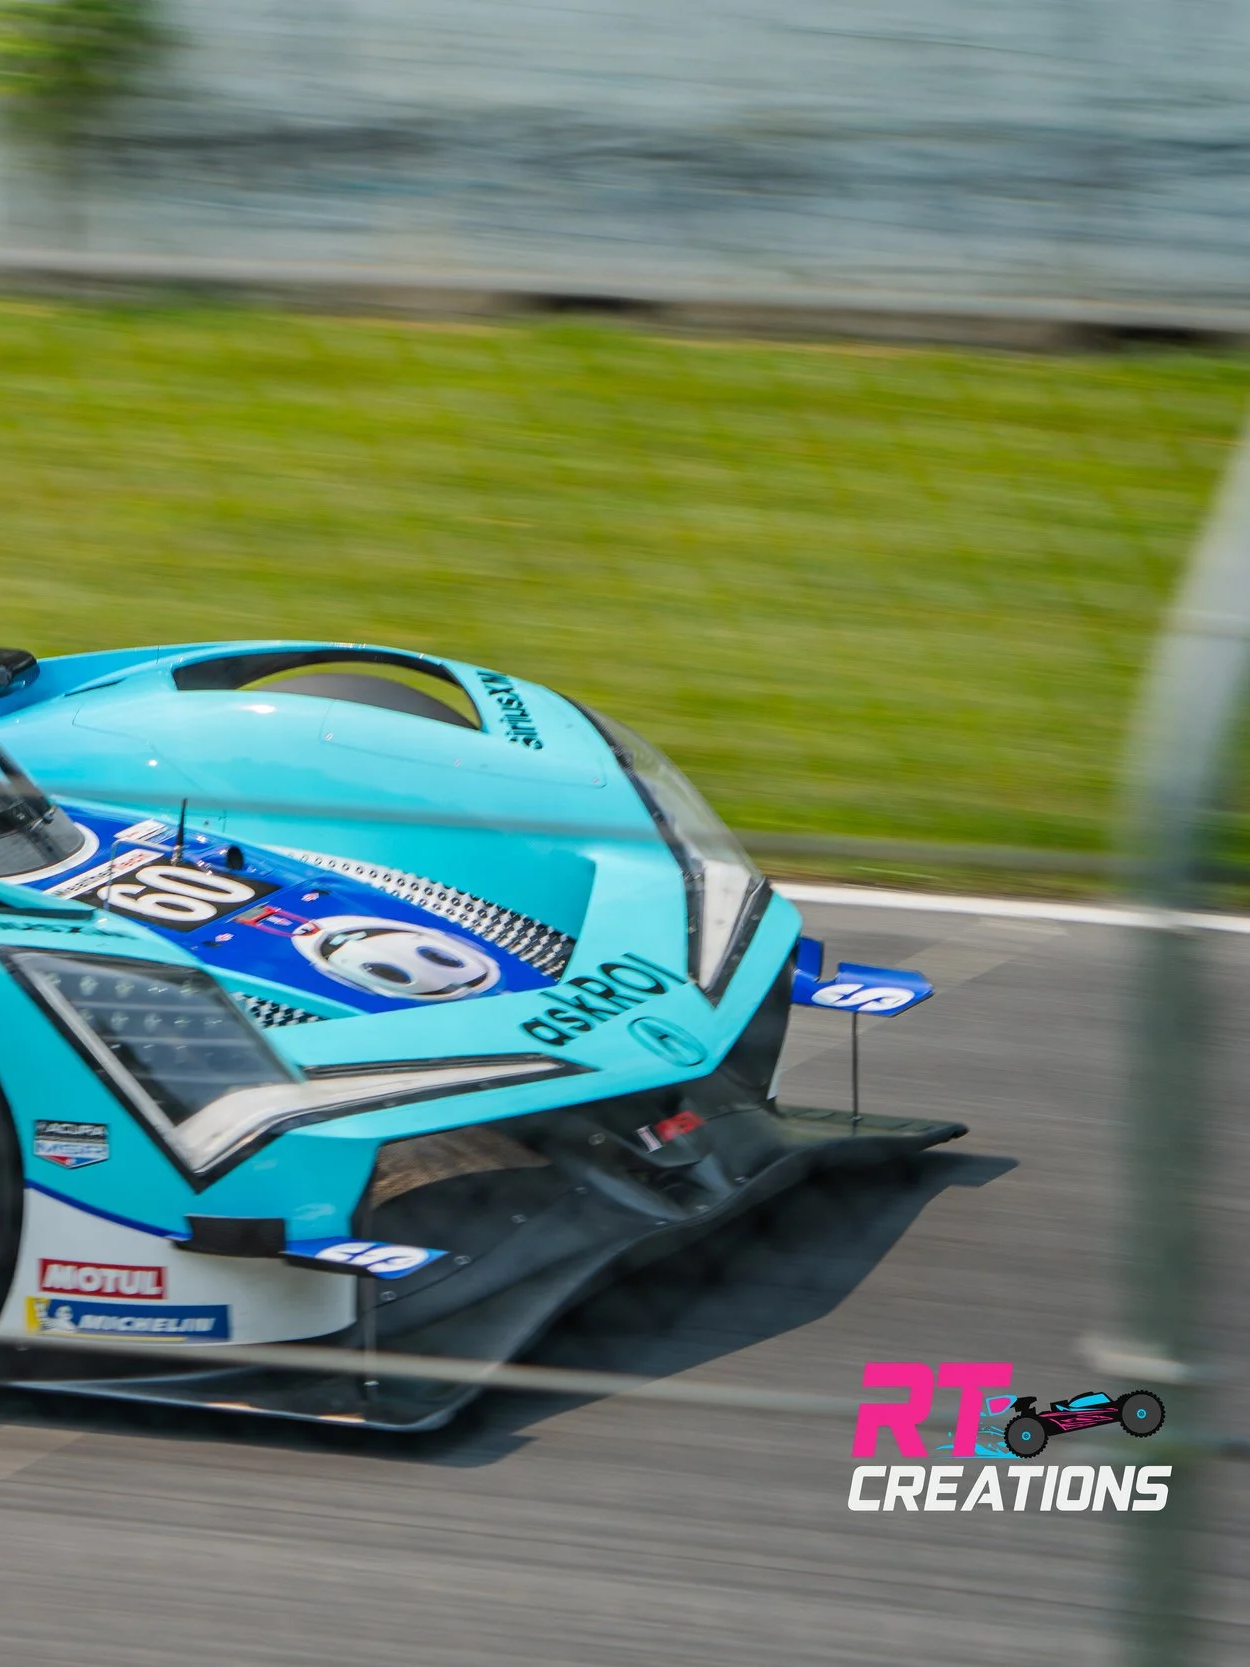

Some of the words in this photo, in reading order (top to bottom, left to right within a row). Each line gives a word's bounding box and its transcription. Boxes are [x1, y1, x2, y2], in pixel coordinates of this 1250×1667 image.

[97, 865, 256, 922] 60
[520, 951, 688, 1047] askROI
[43, 1264, 163, 1295] MOTUL
[78, 1314, 216, 1332] MICHELIN
